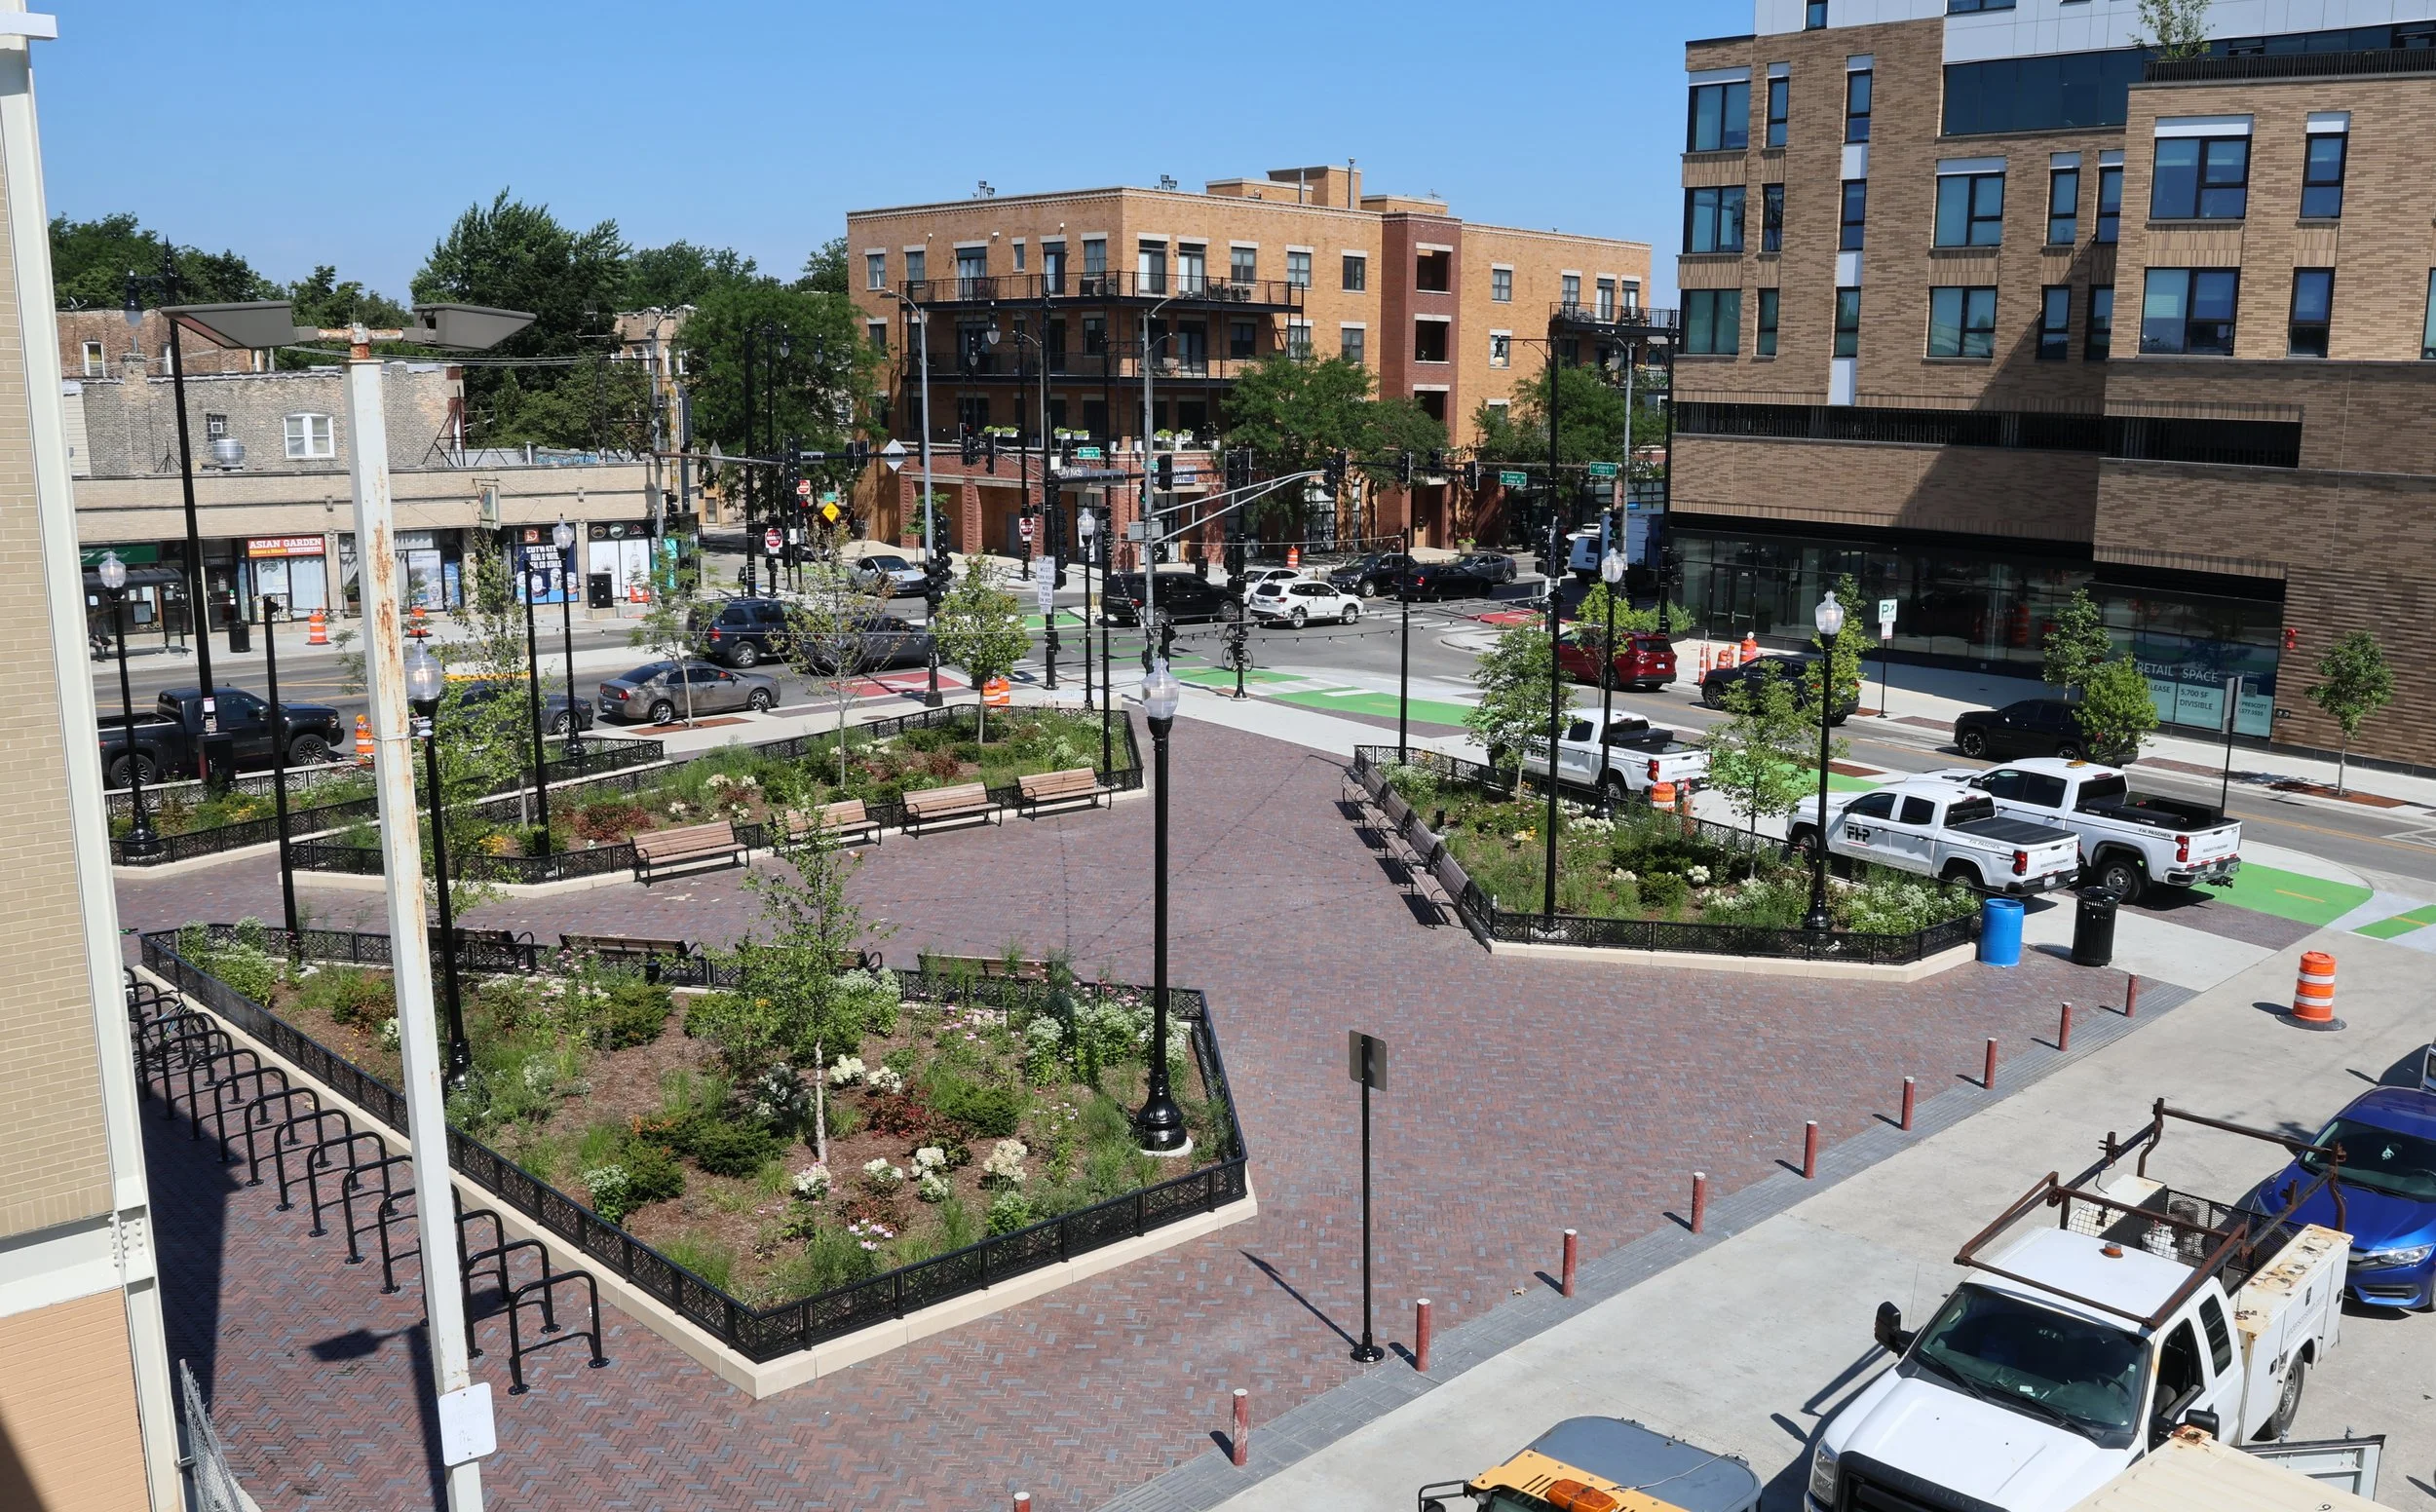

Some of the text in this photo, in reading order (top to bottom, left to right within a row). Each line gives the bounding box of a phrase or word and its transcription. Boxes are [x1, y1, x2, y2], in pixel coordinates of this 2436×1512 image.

[1070, 468, 1083, 476] Kids
[249, 538, 321, 548] ASIAN GARDEN
[1882, 604, 1889, 619] P
[2136, 662, 2219, 682] RETAIL SPACE
[2150, 684, 2171, 694] LEASE
[2180, 699, 2214, 710] DIVISIBLE
[2148, 829, 2172, 839] PASCHEN
